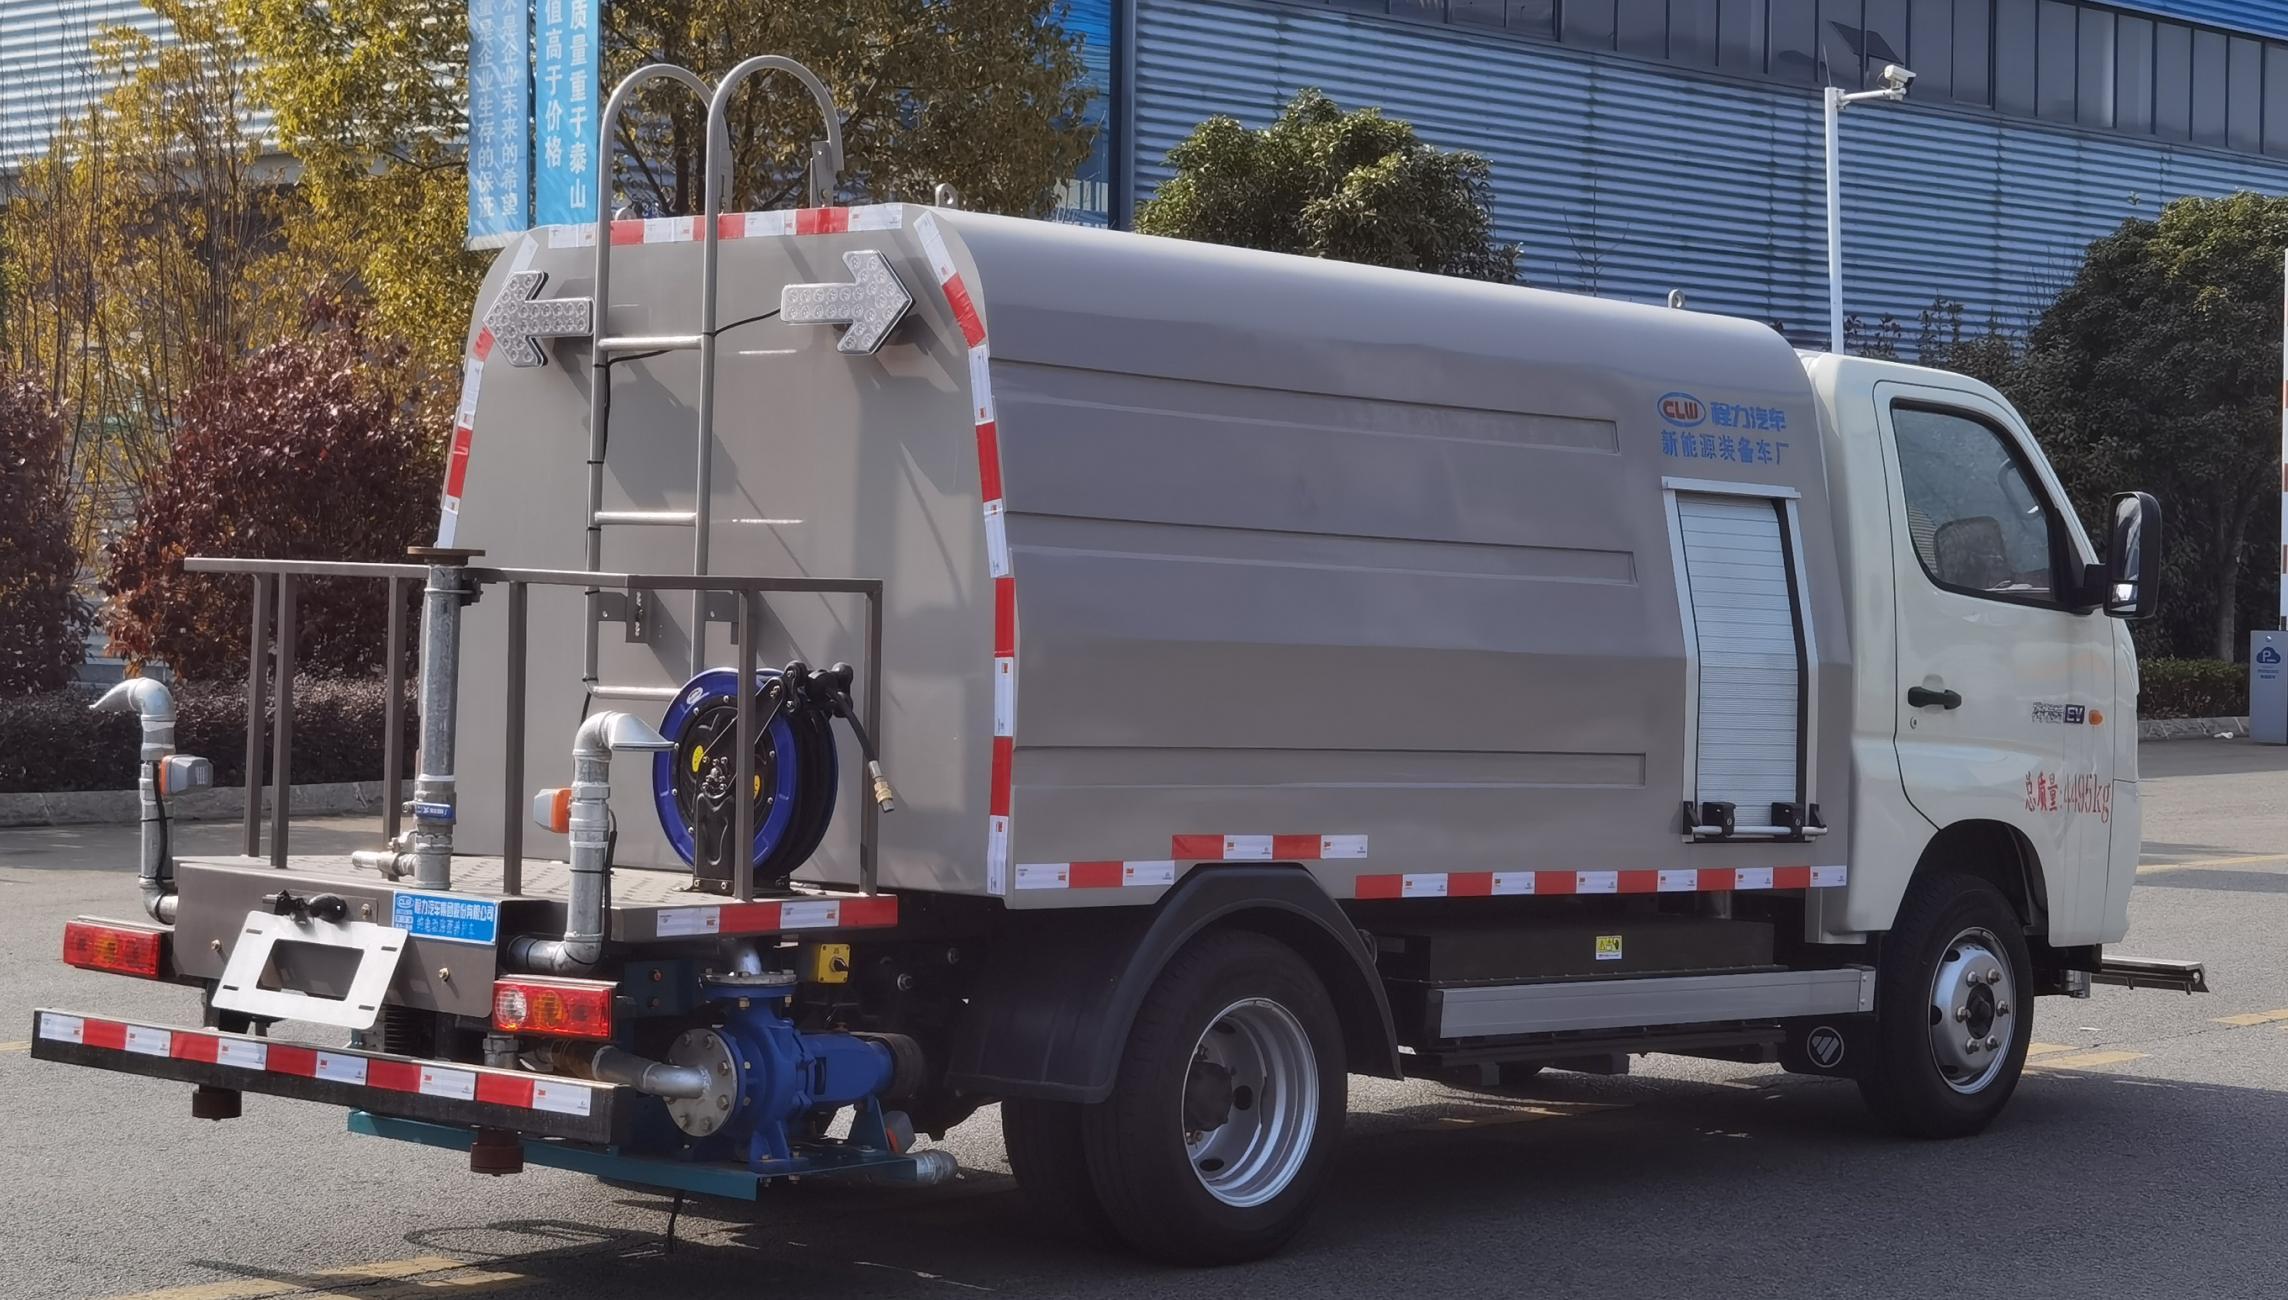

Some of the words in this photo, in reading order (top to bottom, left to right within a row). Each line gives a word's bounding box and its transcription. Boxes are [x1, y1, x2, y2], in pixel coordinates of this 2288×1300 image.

[545, 0, 563, 168] 值高于价格
[570, 0, 587, 209] 质量重于泰山
[1662, 400, 1698, 420] CLW
[1710, 402, 1787, 432] 程力汽车
[1661, 429, 1790, 465] 新能源装备车厂
